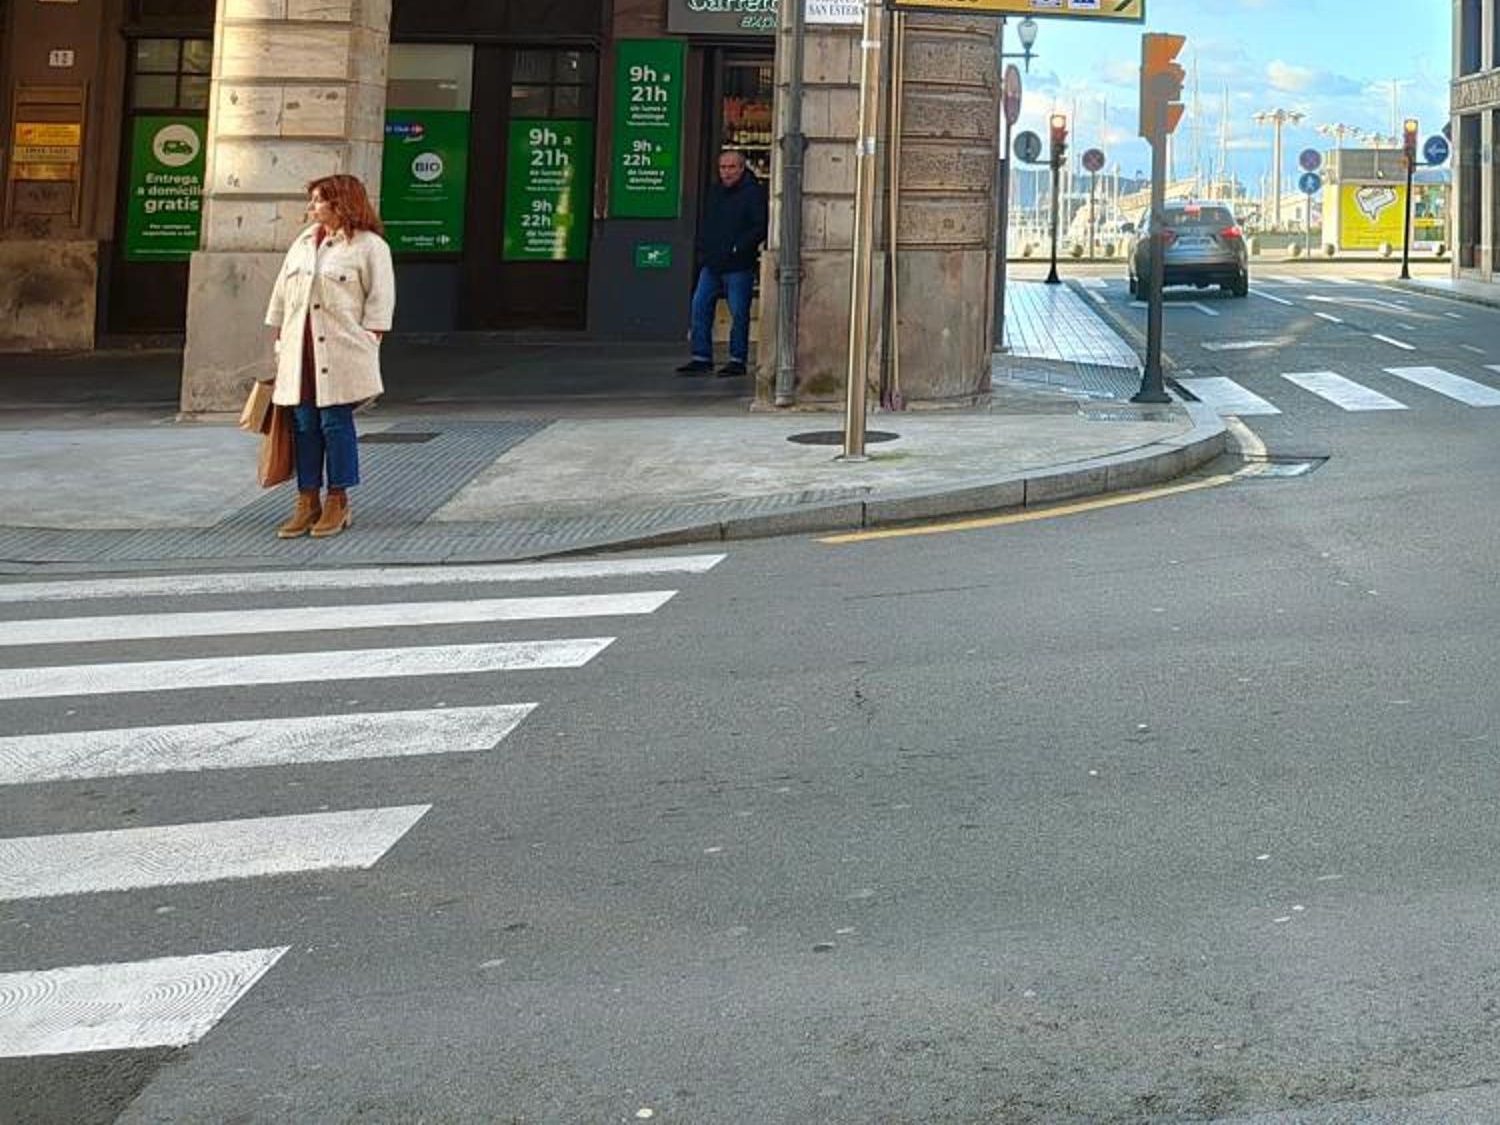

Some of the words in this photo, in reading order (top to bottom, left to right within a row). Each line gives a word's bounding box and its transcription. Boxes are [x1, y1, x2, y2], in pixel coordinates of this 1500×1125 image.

[740, 14, 777, 31] exp
[630, 65, 657, 82] 9h
[631, 85, 667, 102] 21h
[529, 128, 557, 145] 9h
[563, 136, 572, 145] a
[633, 140, 651, 152] 9h
[530, 149, 568, 166] 21h
[623, 154, 651, 166] 22h
[415, 162, 440, 172] BIO
[146, 172, 199, 185] Entrega
[148, 185, 201, 195] domicili
[144, 197, 199, 214] gratis
[531, 200, 552, 213] 9h
[521, 214, 551, 227] 22h
